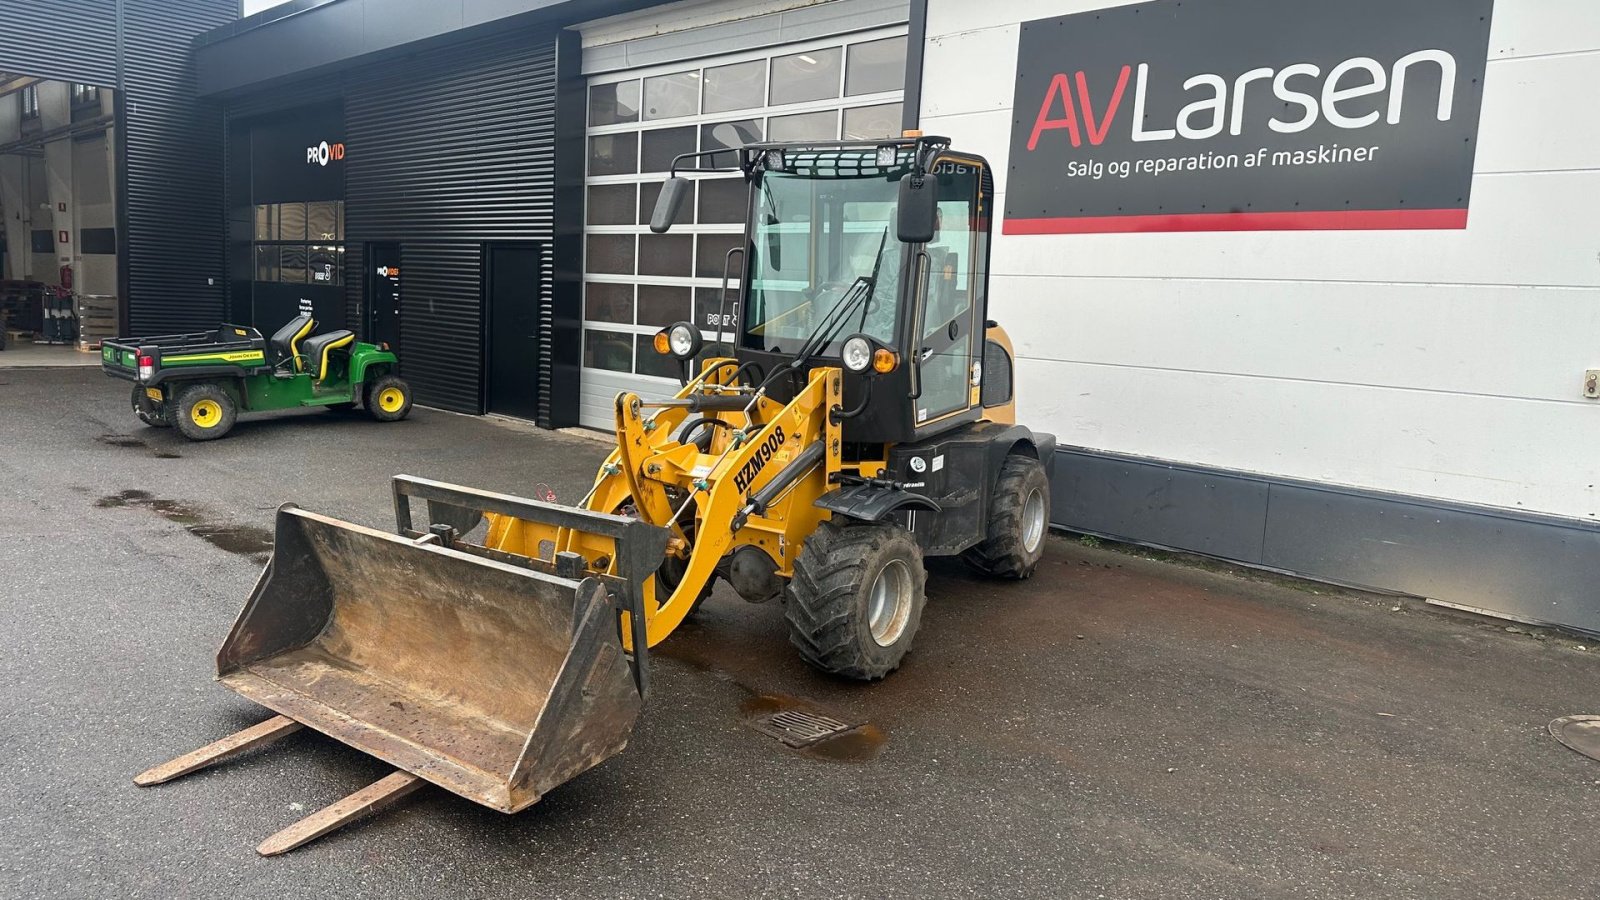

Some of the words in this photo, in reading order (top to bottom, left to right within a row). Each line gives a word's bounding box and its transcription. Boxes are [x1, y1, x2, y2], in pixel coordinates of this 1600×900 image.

[1067, 159, 1103, 180] Salg
[1107, 160, 1131, 179] og
[1135, 151, 1239, 177] reparation
[1243, 147, 1268, 168] af
[1271, 145, 1380, 166] maskiner
[707, 313, 730, 326] POT
[733, 425, 786, 496] HZM908
